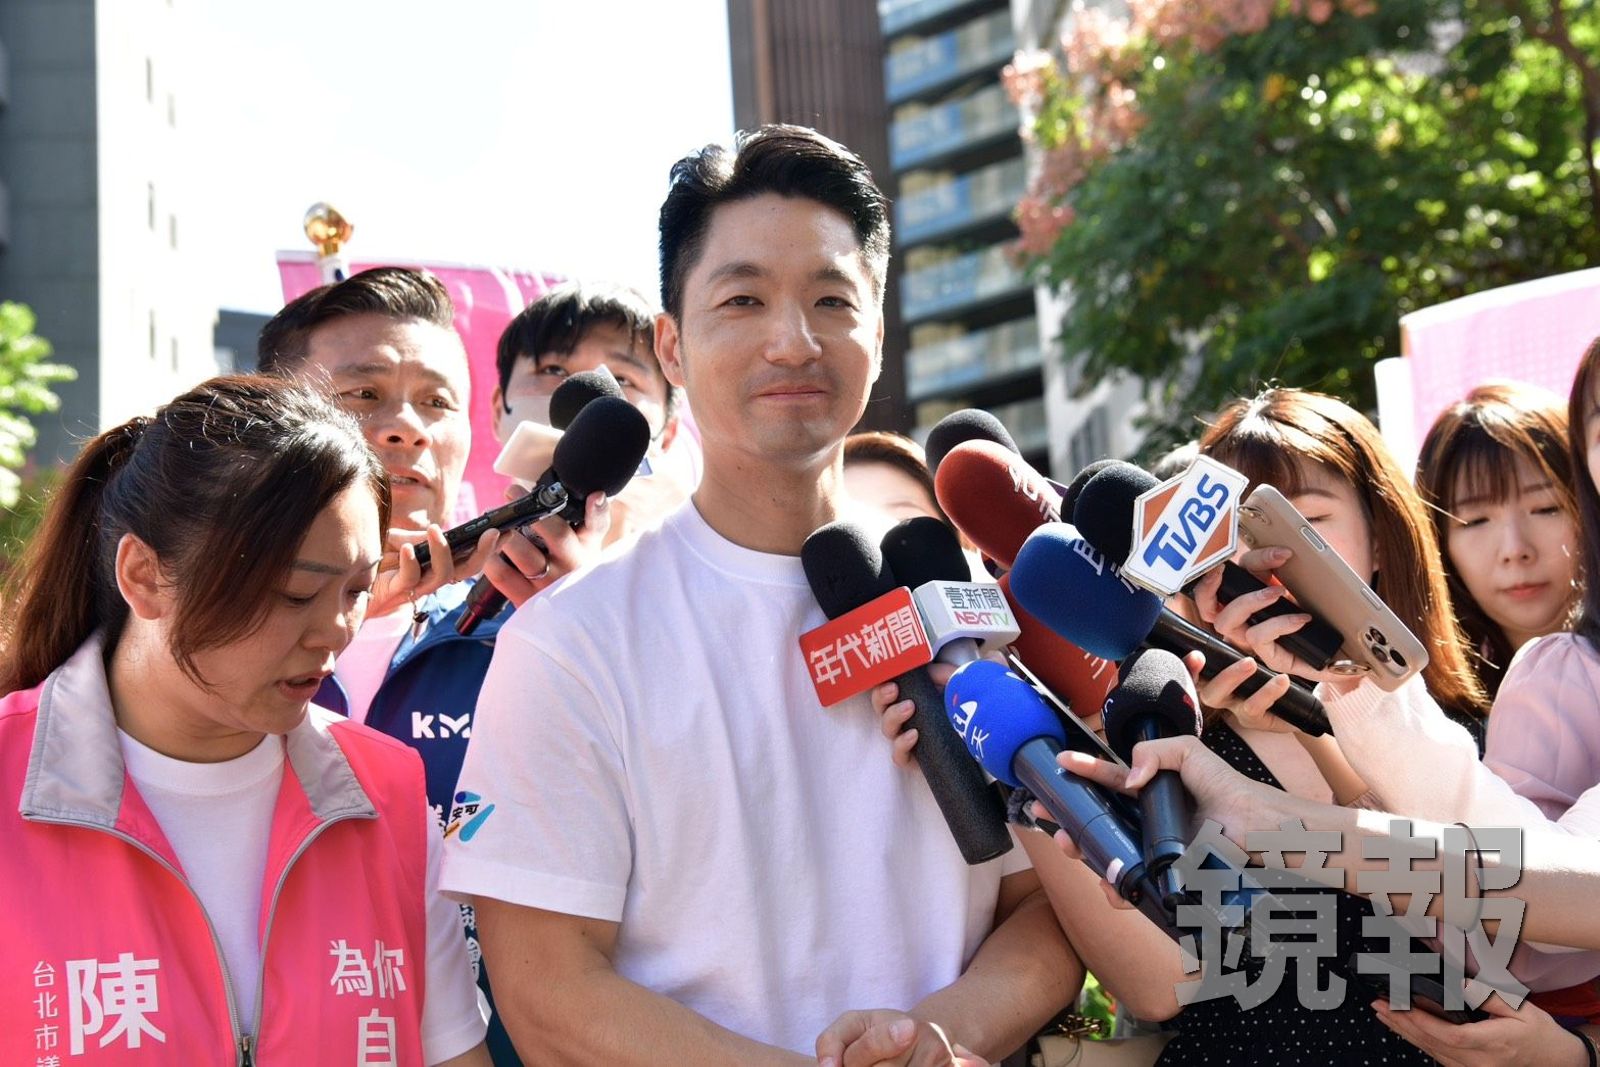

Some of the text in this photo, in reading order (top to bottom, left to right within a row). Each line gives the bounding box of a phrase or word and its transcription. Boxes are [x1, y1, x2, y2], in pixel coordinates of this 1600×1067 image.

[1143, 473, 1229, 571] TVBS
[943, 586, 1005, 609] 壹新聞
[809, 605, 923, 685] 年代新聞
[66, 952, 166, 1056] 陳
[329, 939, 406, 999] 為你
